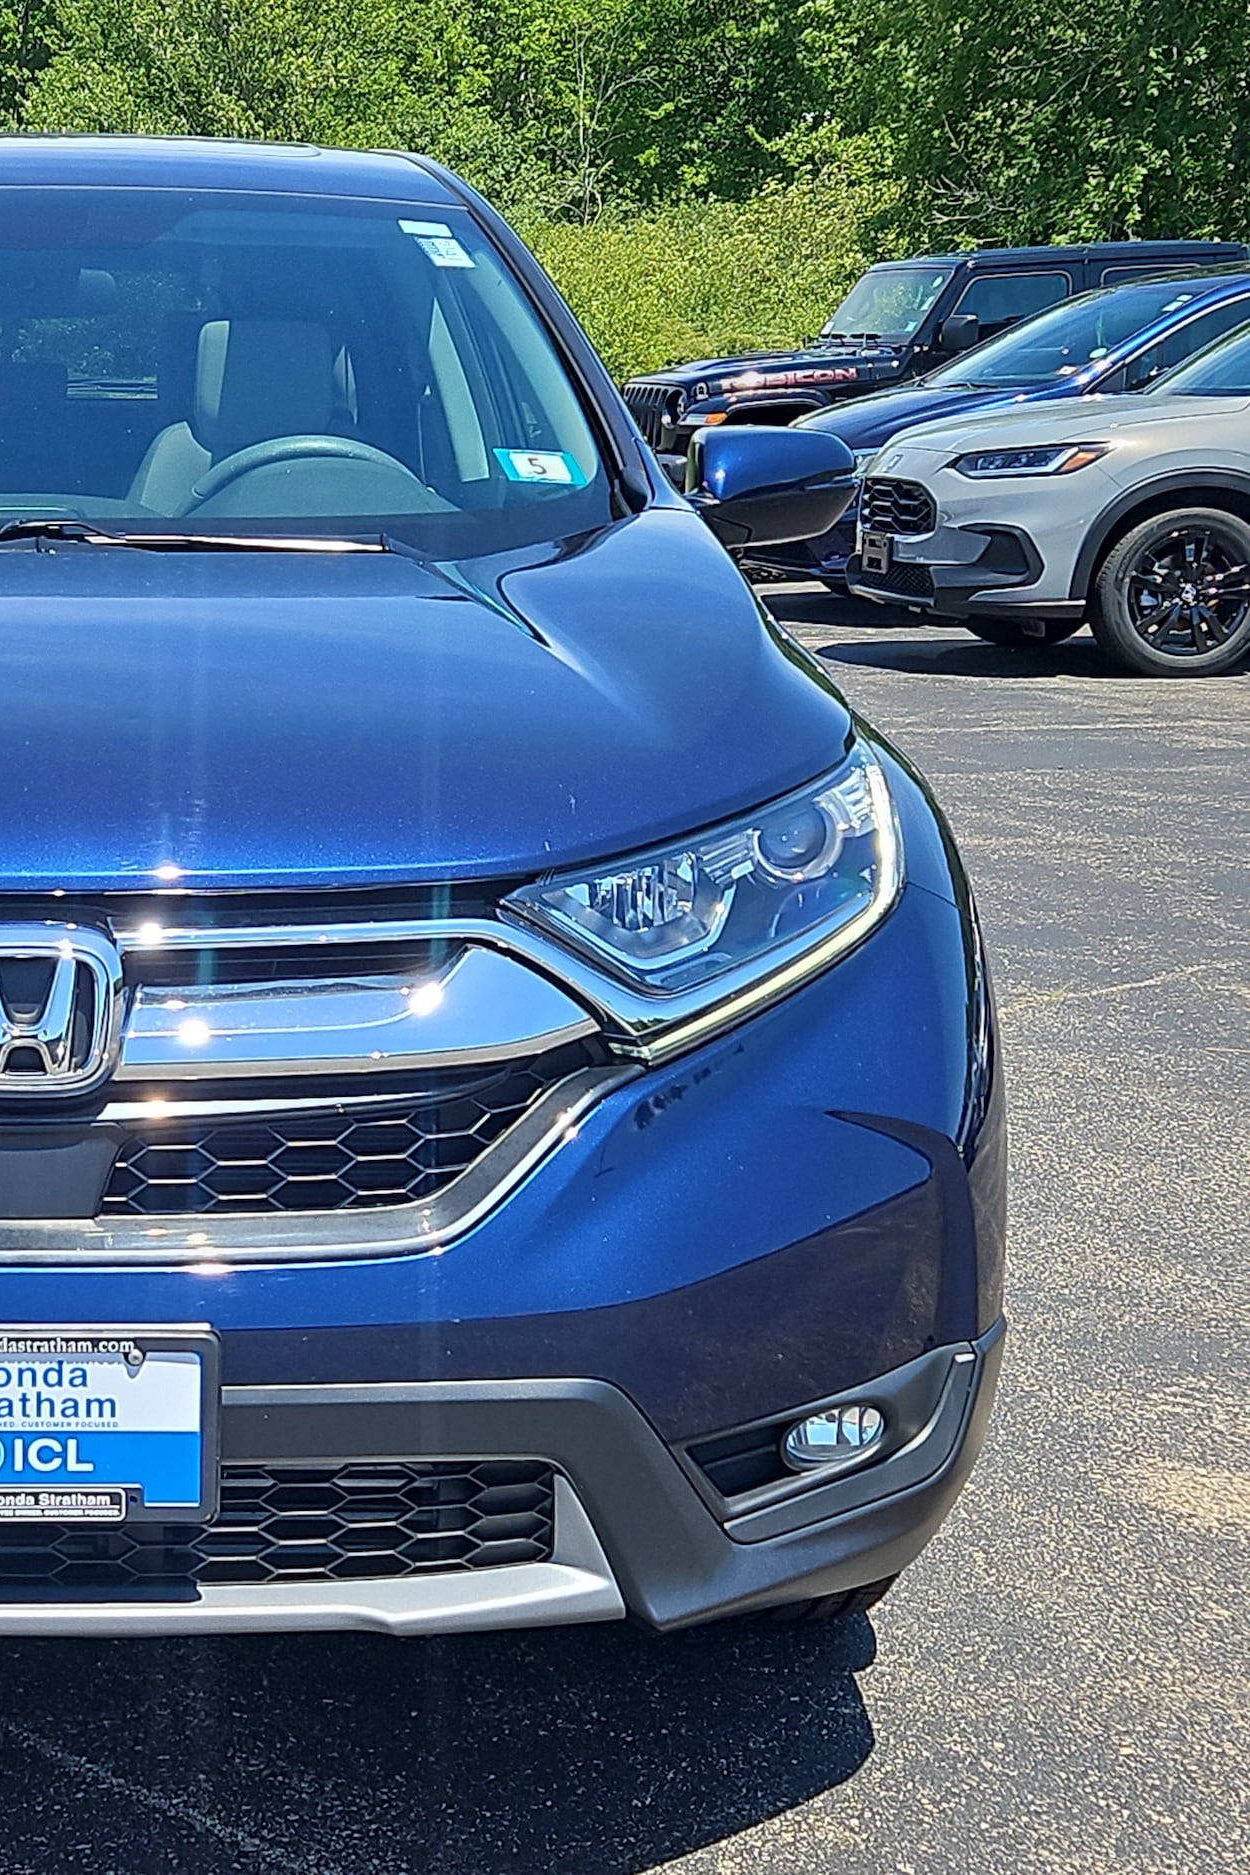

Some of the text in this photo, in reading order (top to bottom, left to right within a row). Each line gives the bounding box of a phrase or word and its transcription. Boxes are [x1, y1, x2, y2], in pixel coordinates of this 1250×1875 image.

[527, 457, 547, 475] 5
[13, 1438, 94, 1472] ICL
[39, 1493, 111, 1506] Stratham
